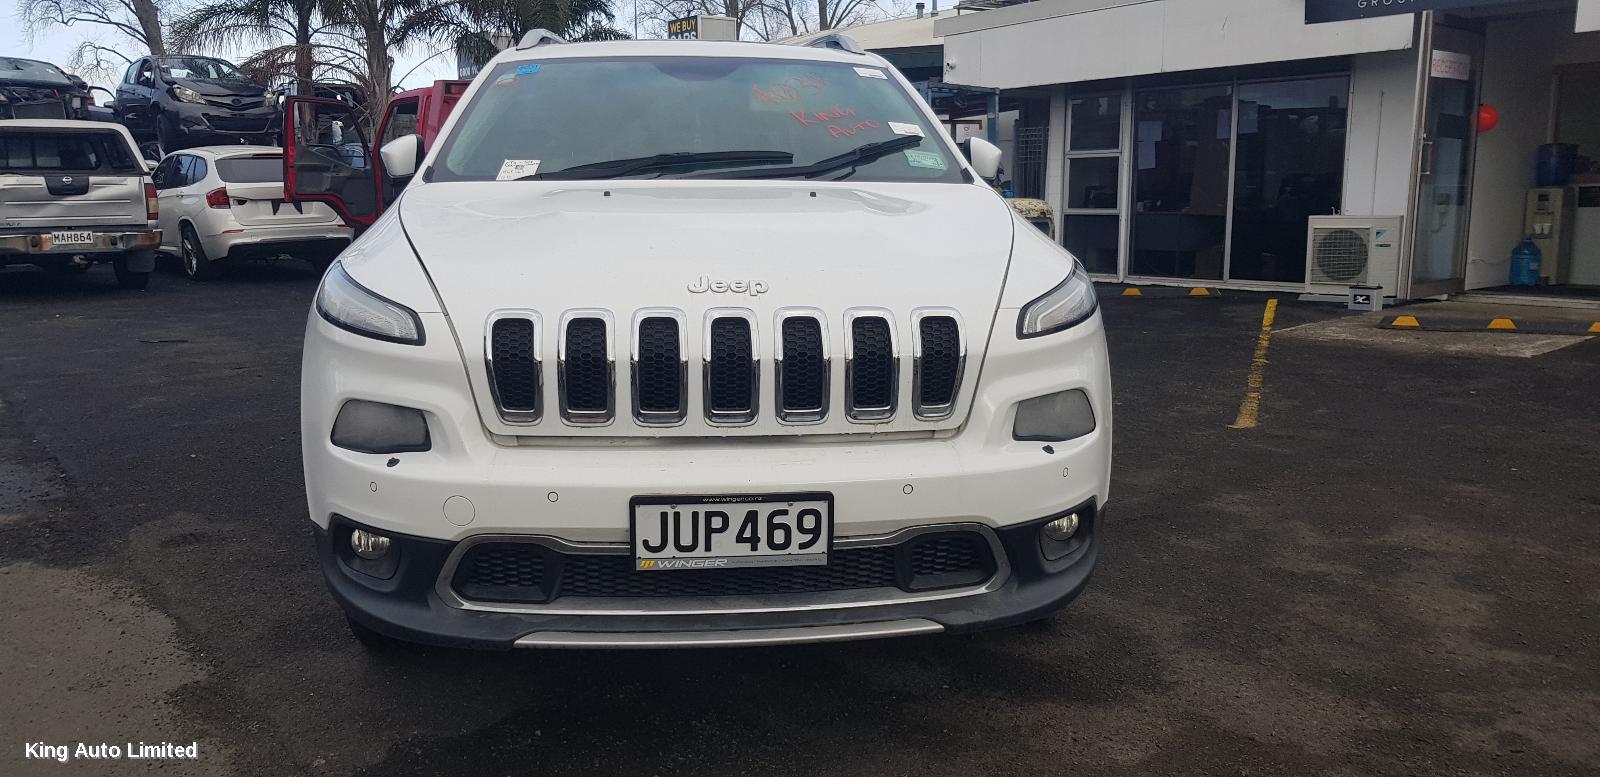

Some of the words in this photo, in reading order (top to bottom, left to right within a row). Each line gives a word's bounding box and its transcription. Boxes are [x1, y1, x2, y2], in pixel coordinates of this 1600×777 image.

[1357, 0, 1414, 8] GRO
[670, 22, 681, 33] WE
[682, 19, 696, 31] BUY
[53, 232, 92, 243] MAH864
[687, 275, 769, 297] Jeep
[642, 508, 822, 553] JUP469
[657, 558, 728, 569] WINGER
